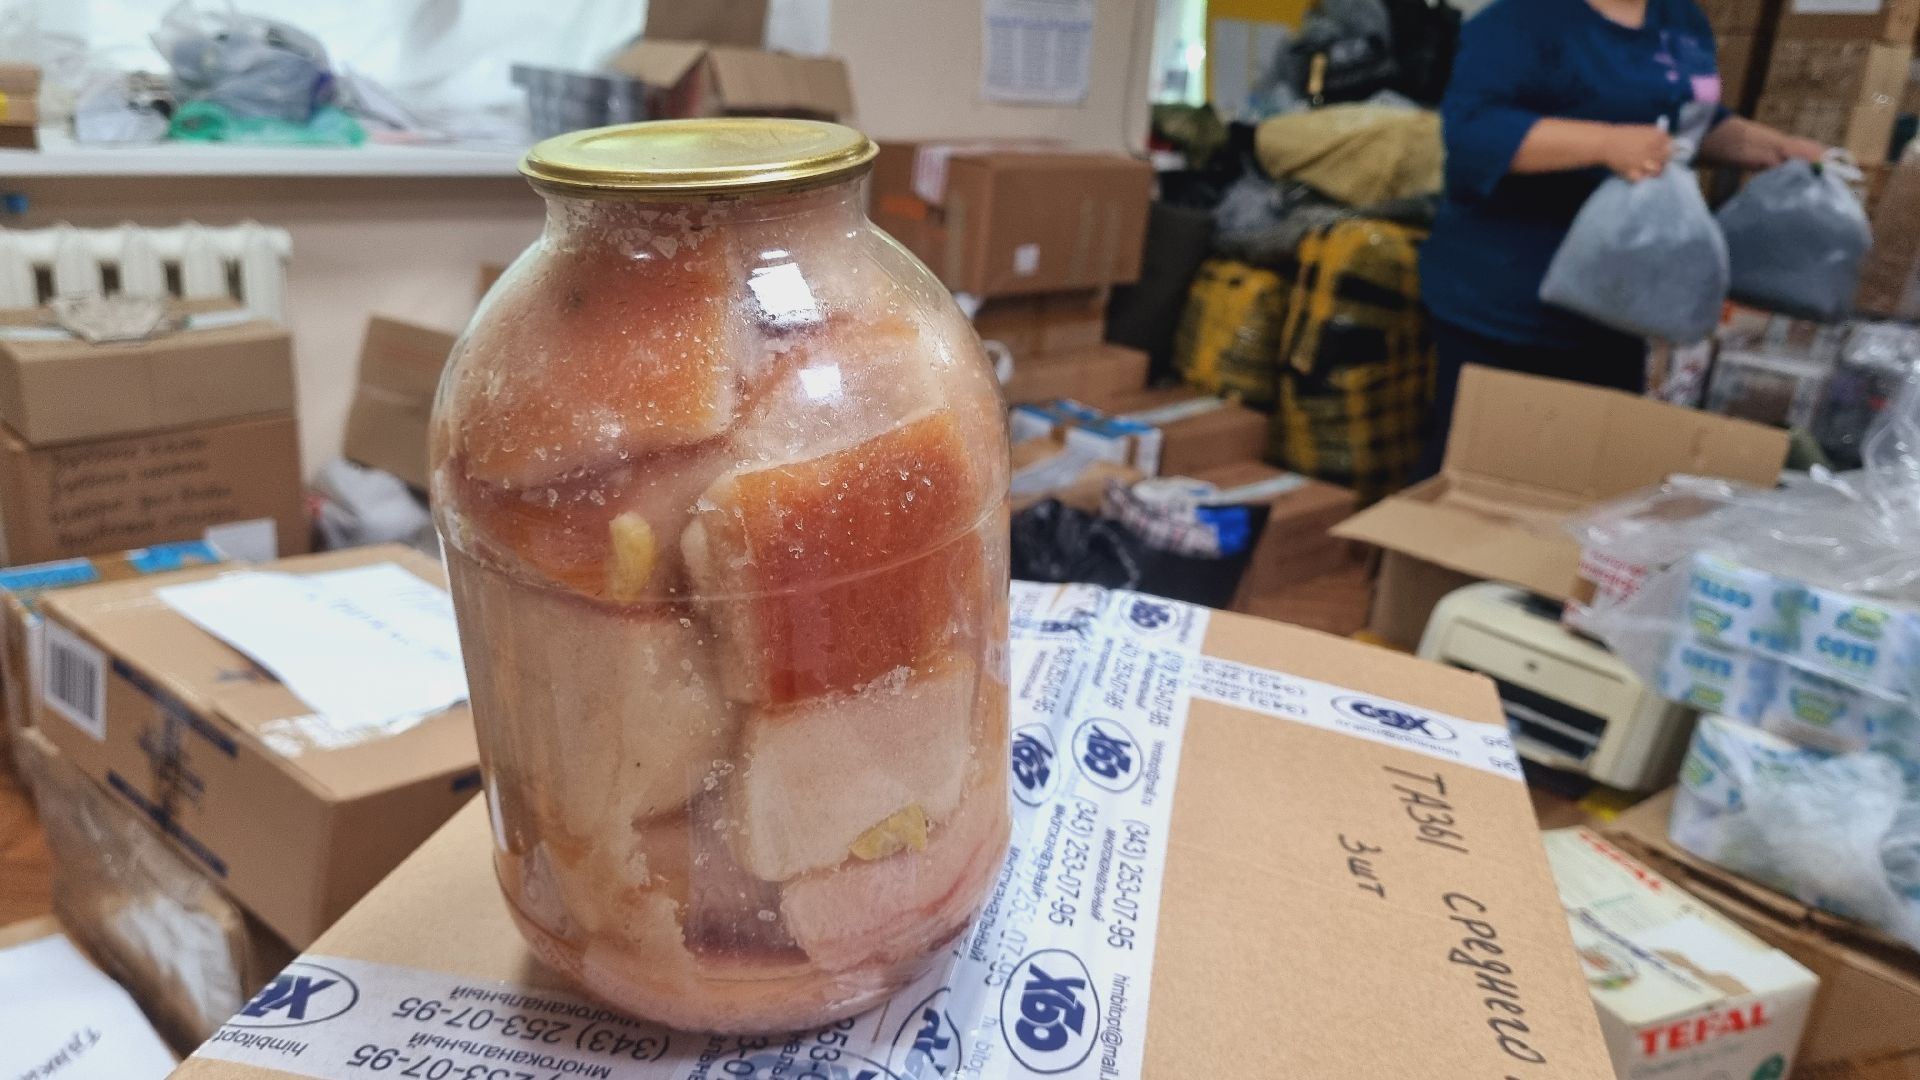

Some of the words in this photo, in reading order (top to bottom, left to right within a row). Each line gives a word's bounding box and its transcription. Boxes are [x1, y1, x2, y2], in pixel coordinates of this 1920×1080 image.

[1117, 818, 1151, 861] (343)
[1048, 838, 1090, 928] 253-07-95
[1106, 860, 1144, 951] 253-07-95
[392, 996, 564, 1046] 253-07-95
[576, 1020, 672, 1064] (343)
[1636, 1001, 1771, 1058] TEFAL
[408, 1031, 613, 1080] многоканальный
